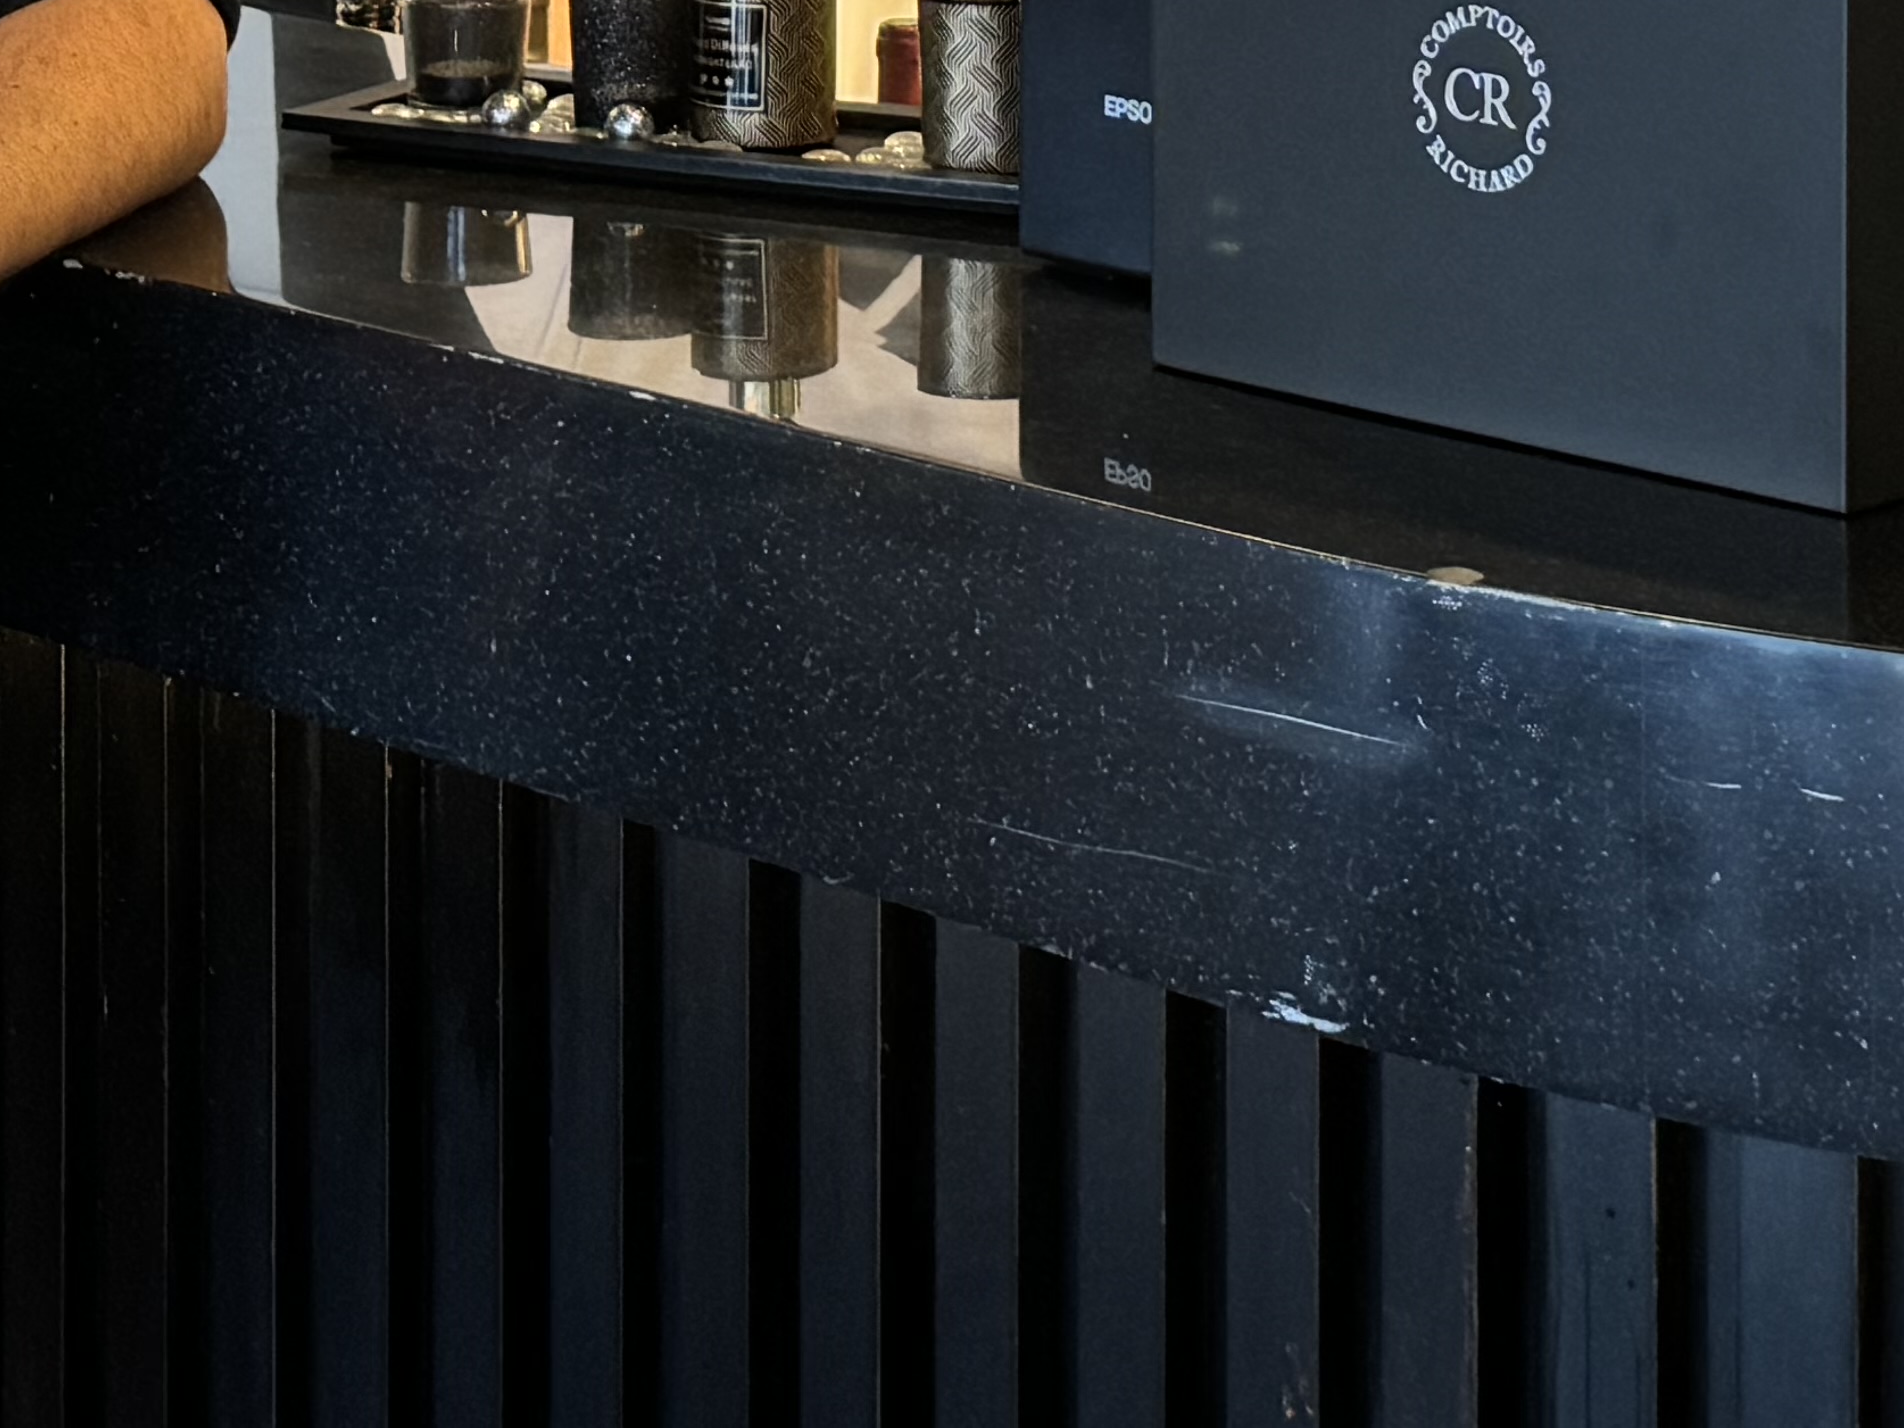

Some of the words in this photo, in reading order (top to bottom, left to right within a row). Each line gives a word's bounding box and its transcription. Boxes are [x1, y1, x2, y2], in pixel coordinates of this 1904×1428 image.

[1420, 4, 1546, 78] COMPTOIRS
[1104, 94, 1152, 125] EPSO
[1444, 67, 1519, 131] CR
[1425, 134, 1534, 193] RICHARD
